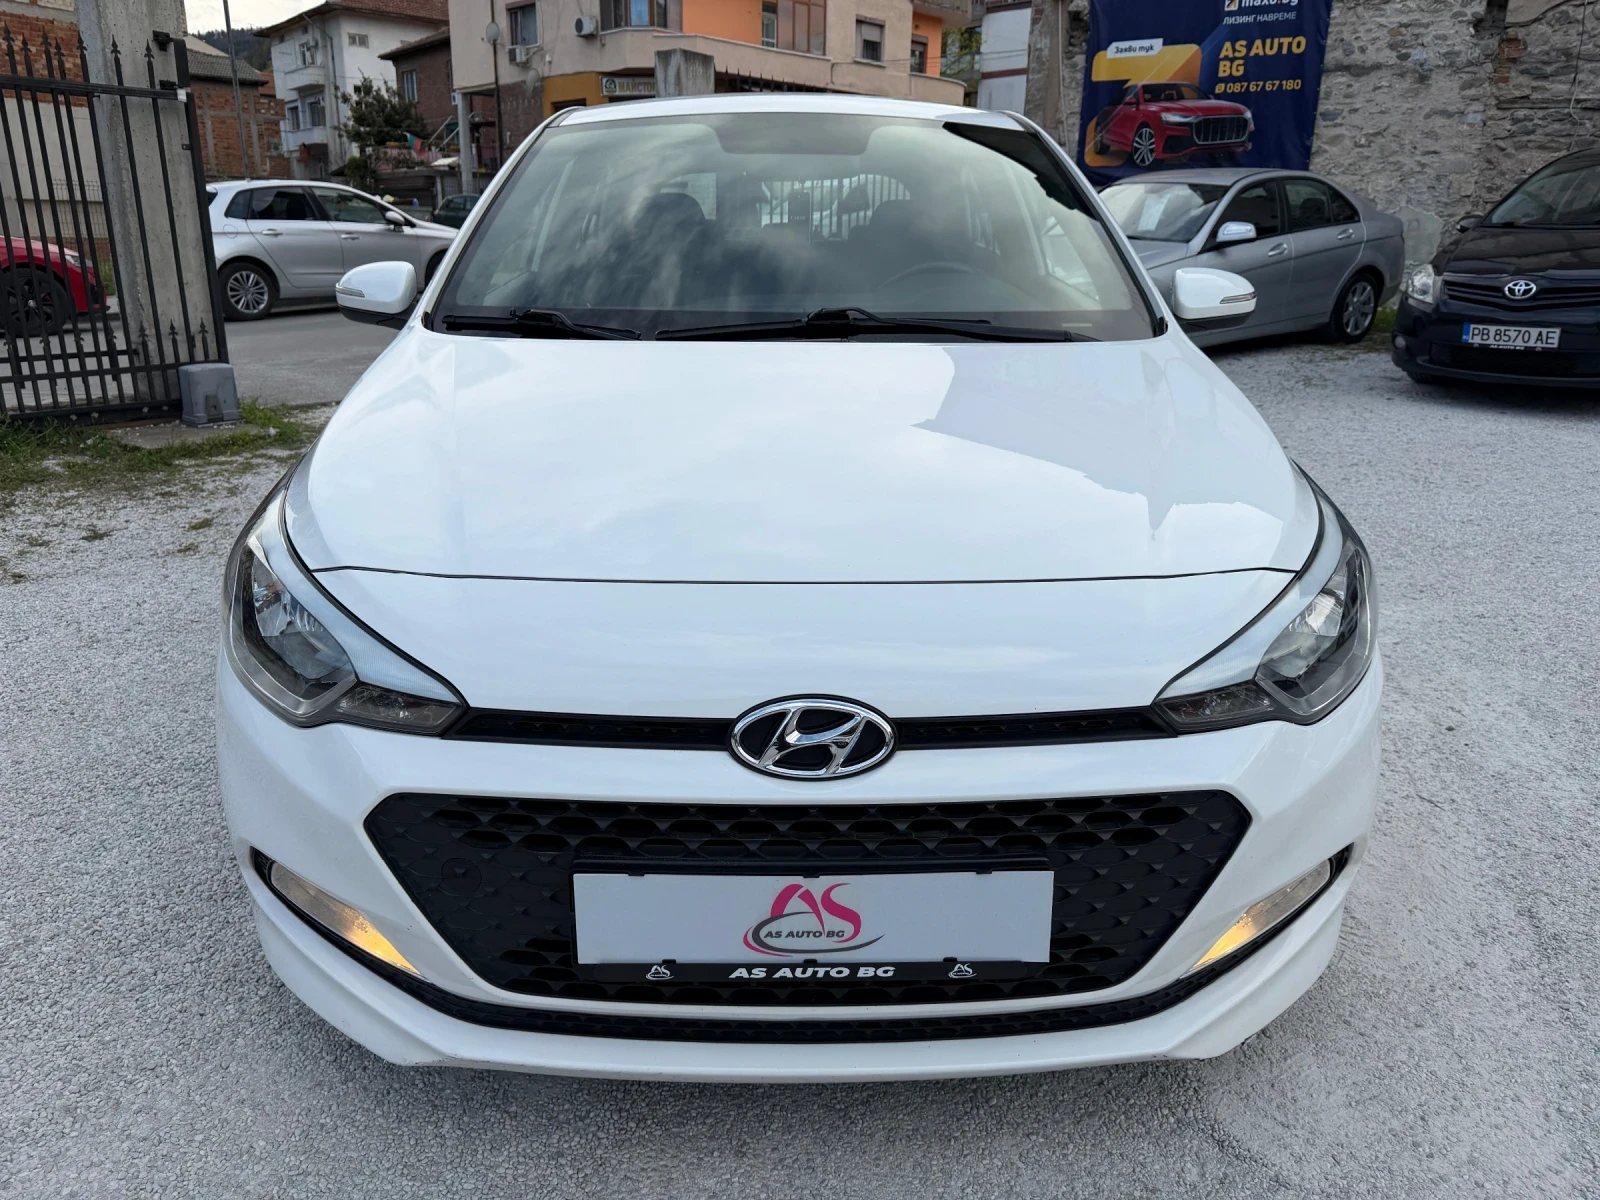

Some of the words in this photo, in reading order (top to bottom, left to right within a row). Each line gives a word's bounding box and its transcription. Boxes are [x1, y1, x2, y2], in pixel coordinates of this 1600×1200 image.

[1223, 14, 1256, 25] ЛИЗИНГ
[1257, 11, 1297, 22] НАВРЕМЕ
[1219, 40, 1247, 59] AS
[1249, 36, 1306, 56] AUTO
[1218, 59, 1245, 77] BG
[1226, 82, 1248, 93] 087
[1249, 81, 1264, 92] 67
[1265, 80, 1280, 91] 67
[1281, 79, 1302, 91] 180
[1471, 326, 1490, 341] PB
[1493, 328, 1531, 344] 8570
[1534, 330, 1557, 345] AE
[770, 883, 861, 943] AS
[785, 930, 822, 938] AUTO
[826, 930, 845, 938] BG
[728, 967, 768, 978] AS
[772, 967, 850, 978] AUTO
[856, 966, 896, 978] BG
